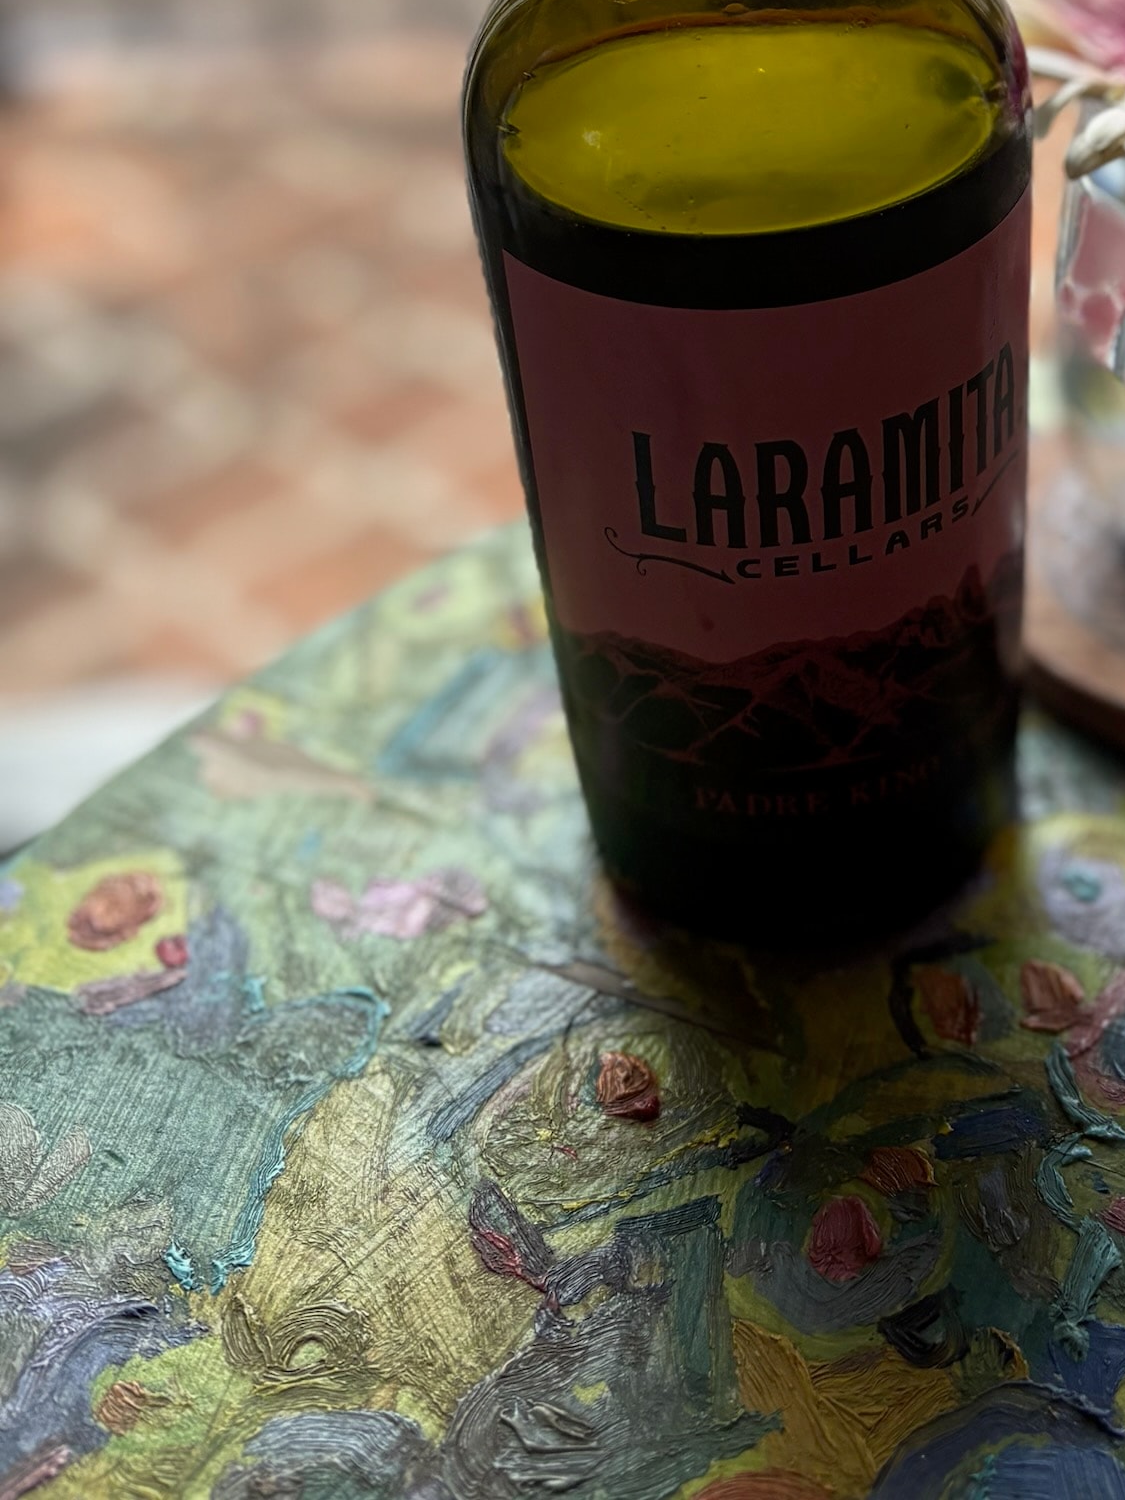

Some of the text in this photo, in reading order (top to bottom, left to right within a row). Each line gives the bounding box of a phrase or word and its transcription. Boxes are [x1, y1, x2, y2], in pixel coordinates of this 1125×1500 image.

[631, 341, 1015, 549] LARAMITA
[736, 496, 969, 579] CELLARS
[693, 785, 829, 818] PADRE
